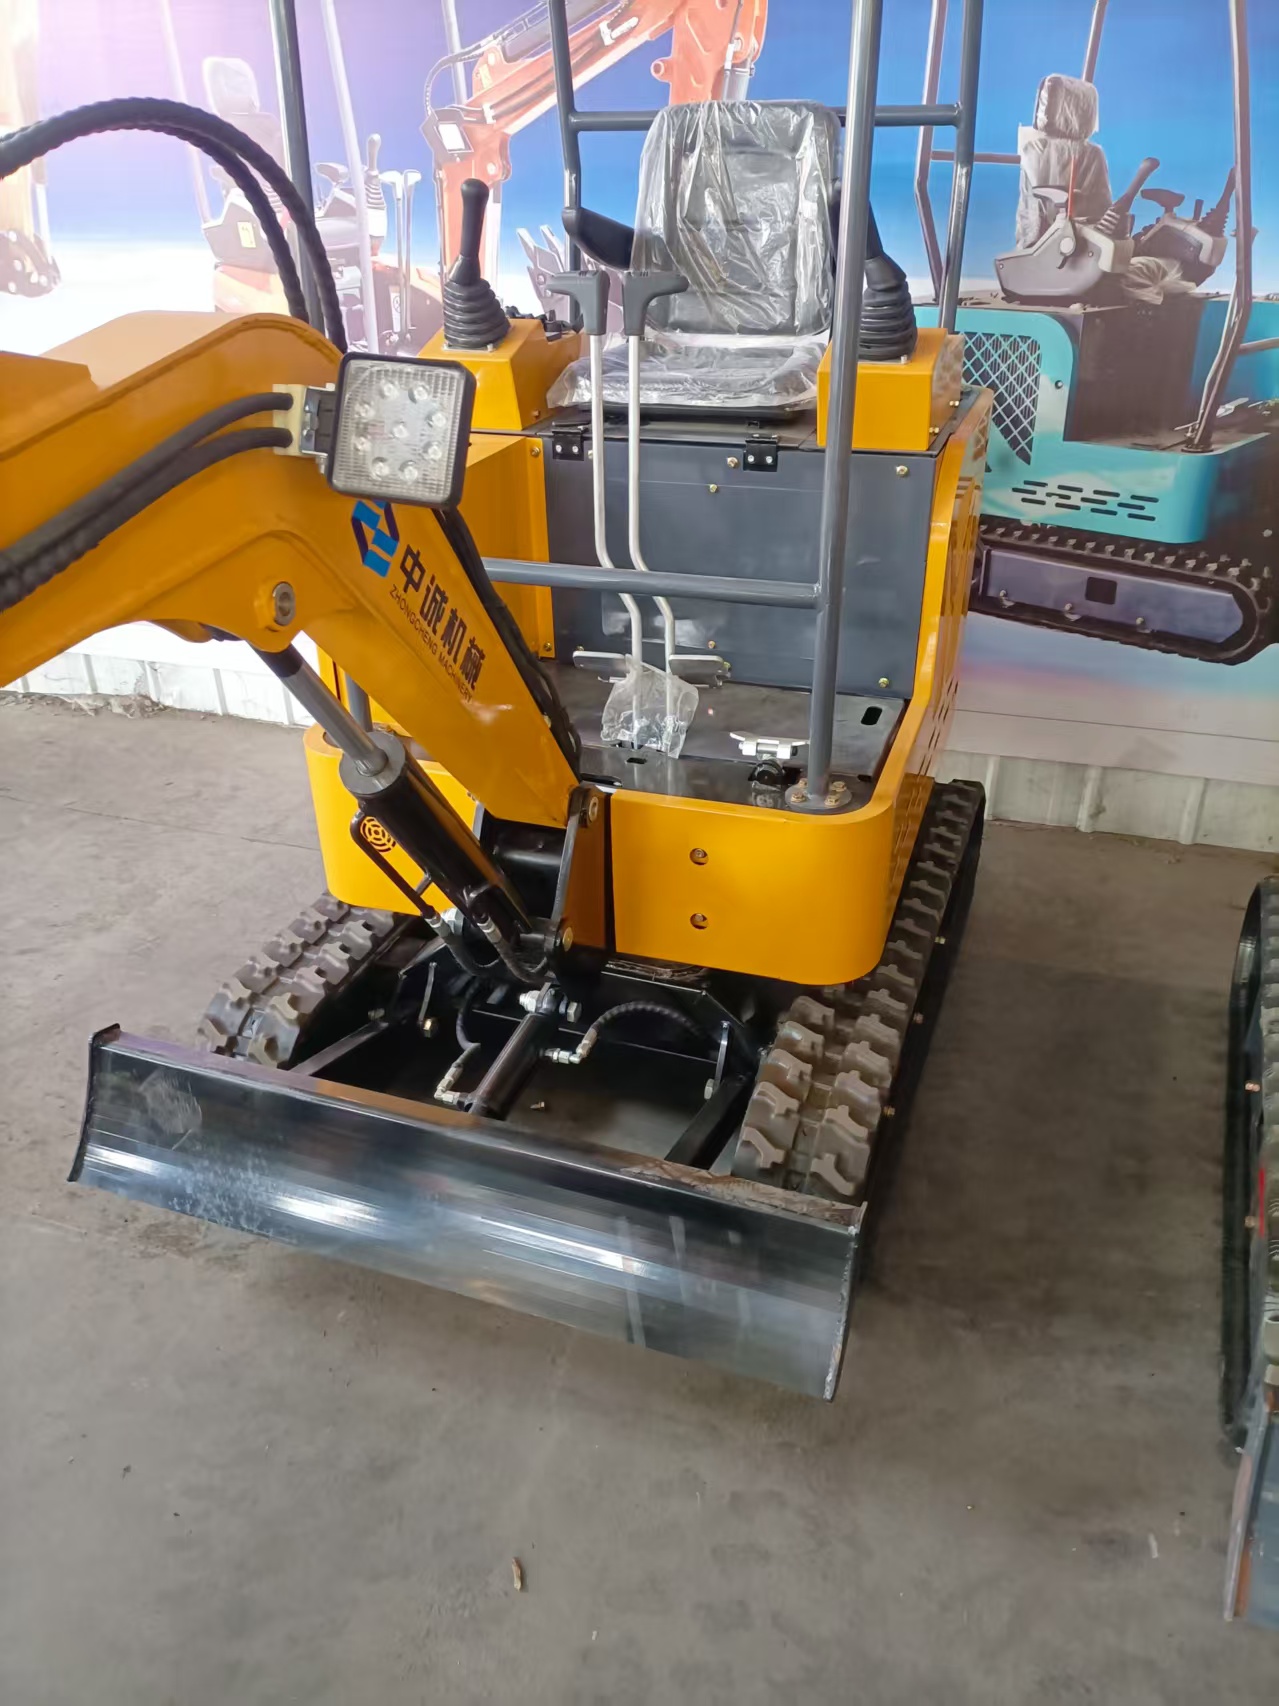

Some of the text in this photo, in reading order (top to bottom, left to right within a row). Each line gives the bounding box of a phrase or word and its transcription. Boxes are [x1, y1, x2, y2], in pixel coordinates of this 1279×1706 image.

[389, 584, 473, 702] ZHONGCHENG MACHINERY
[400, 544, 485, 690] 中诚机械
